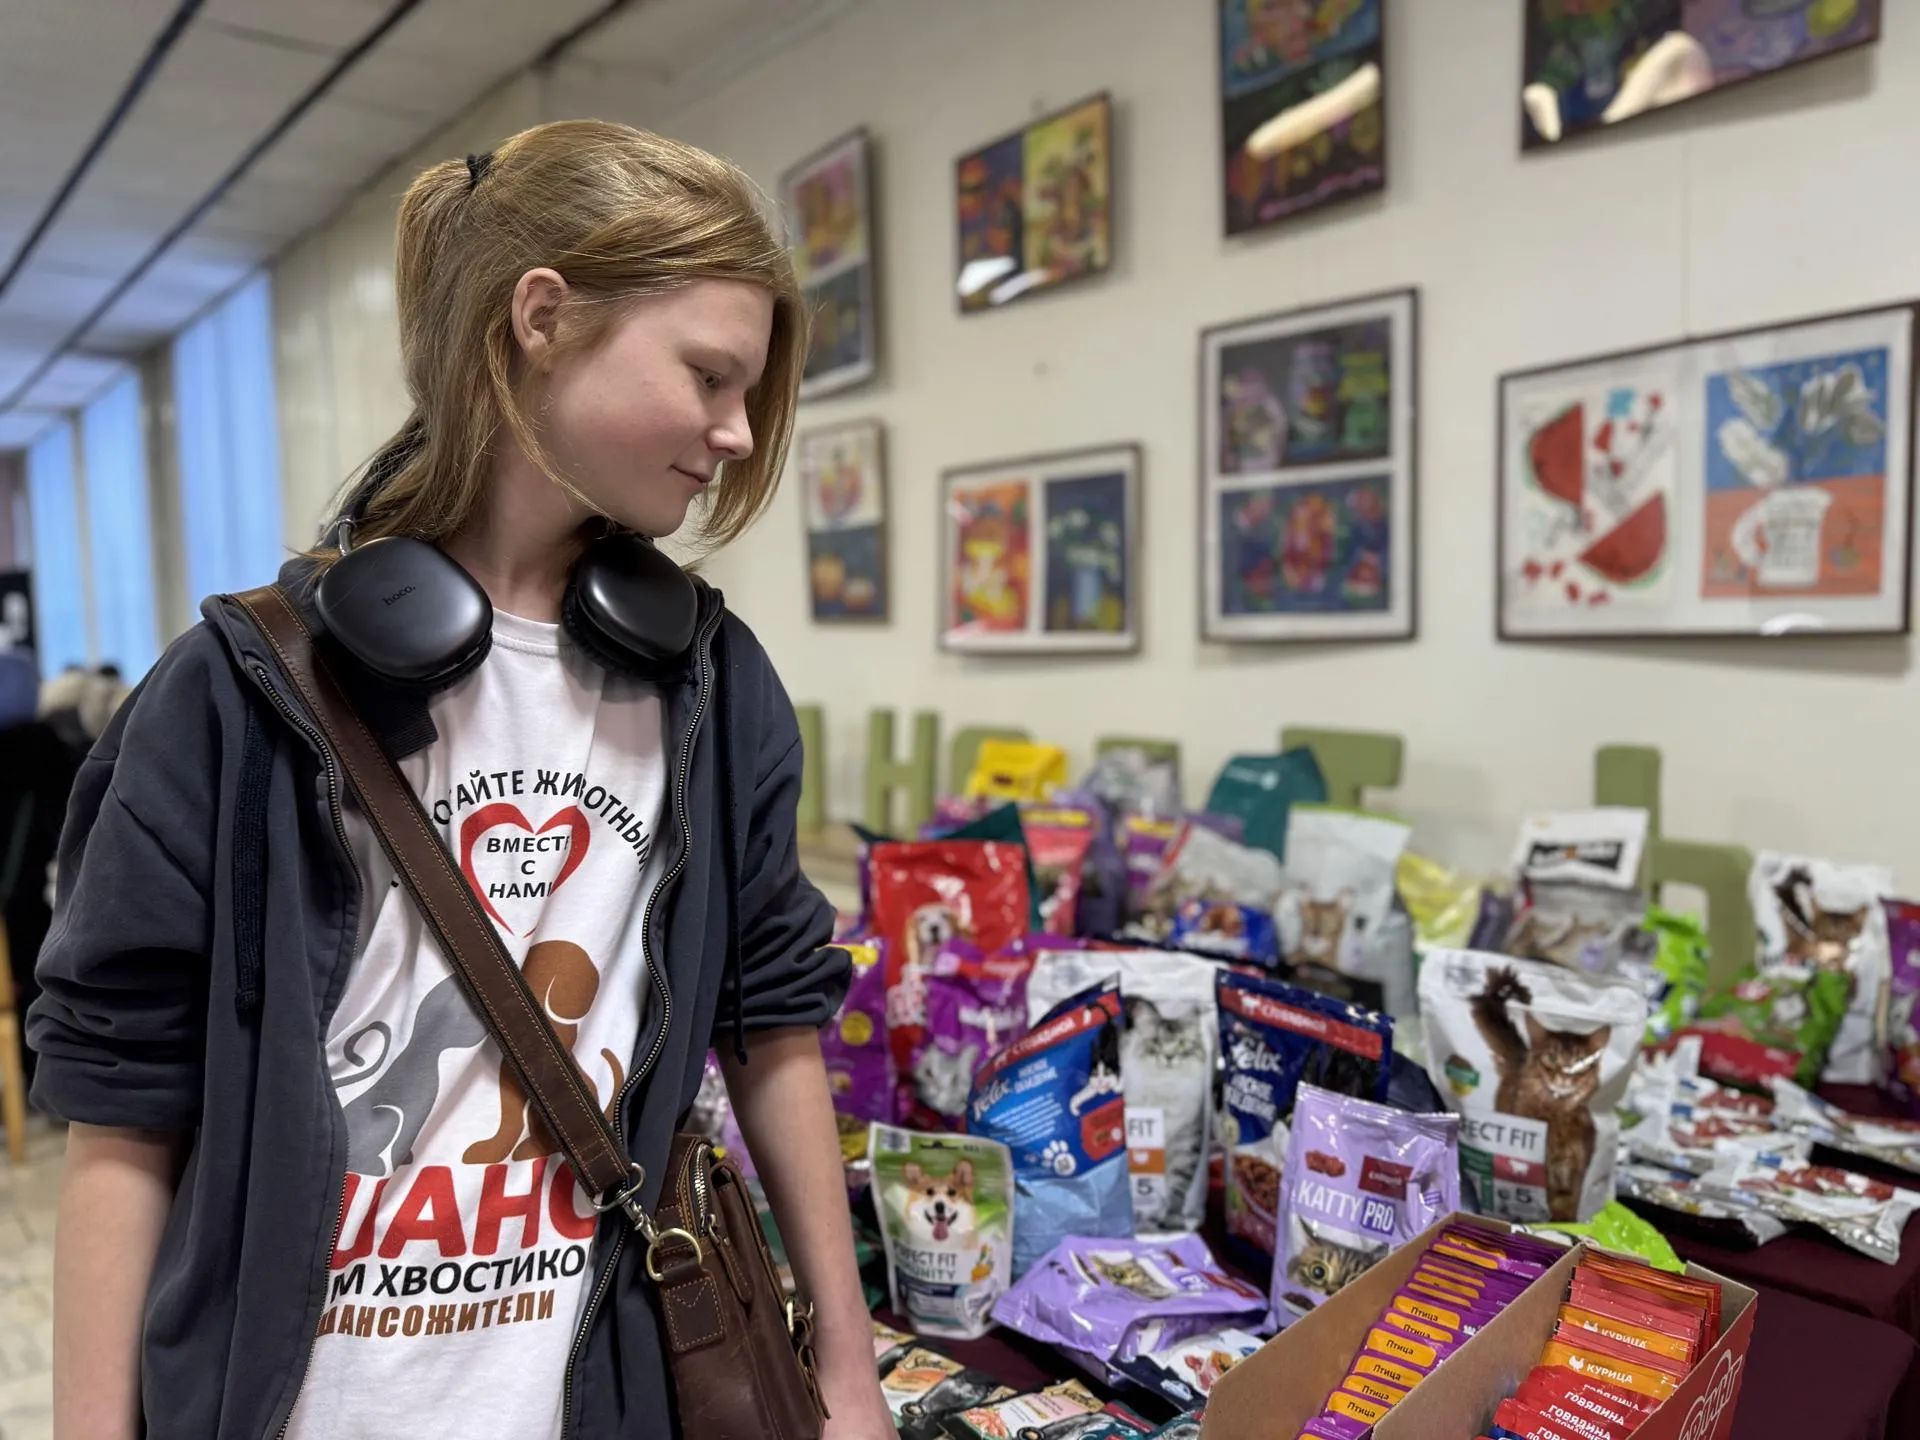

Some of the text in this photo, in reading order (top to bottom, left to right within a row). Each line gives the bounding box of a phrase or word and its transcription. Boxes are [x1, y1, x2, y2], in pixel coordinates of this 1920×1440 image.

[520, 859, 536, 875] С
[1127, 1117, 1155, 1138] FIT
[1509, 1128, 1539, 1151] FIT
[1298, 1179, 1395, 1232] KATTY PRO
[937, 1252, 959, 1268] FIT
[1410, 1306, 1439, 1323] Птица
[1385, 1339, 1414, 1356] Птица
[1372, 1364, 1401, 1381] Птица
[1586, 1363, 1633, 1384] КУРИЦА
[1361, 1385, 1390, 1401] Птица
[1346, 1401, 1376, 1418] Птица
[1564, 1391, 1625, 1426] ГОВЯДИНА
[1547, 1404, 1611, 1440] ГОВЯДИНА
